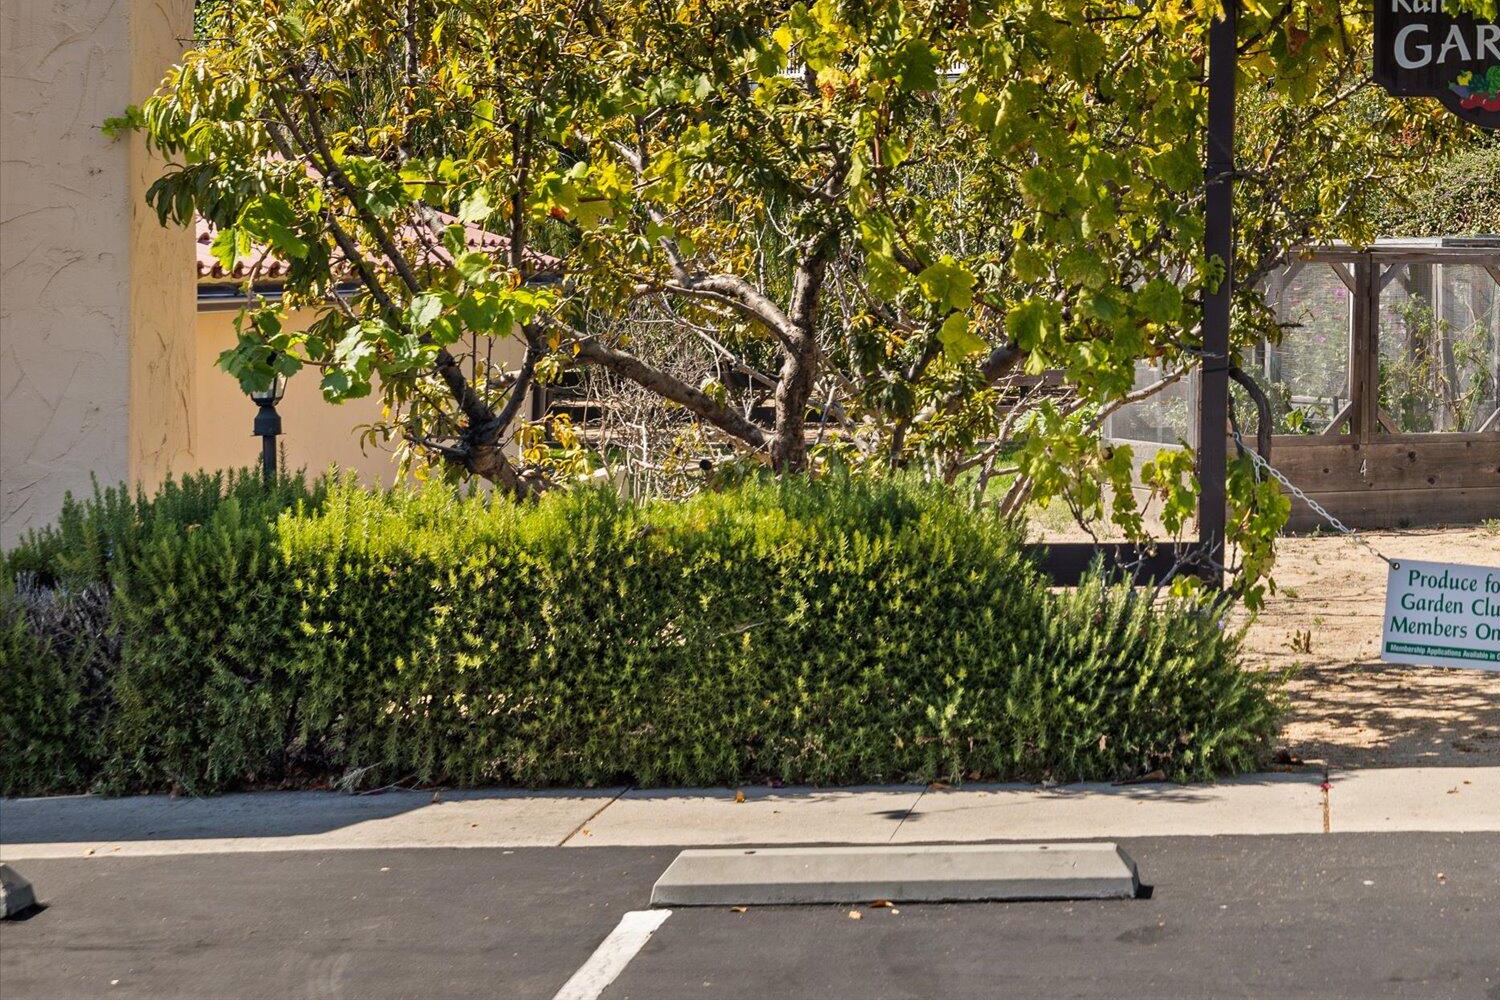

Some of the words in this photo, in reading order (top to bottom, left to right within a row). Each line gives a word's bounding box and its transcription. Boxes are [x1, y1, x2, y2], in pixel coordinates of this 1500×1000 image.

[1360, 459, 1367, 476] 4
[1408, 569, 1477, 592] Produce
[1401, 593, 1463, 614] Garden
[1390, 615, 1468, 639] Members
[1390, 644, 1425, 654] Membership
[1427, 647, 1461, 657] Applications
[1463, 650, 1488, 659] Available
